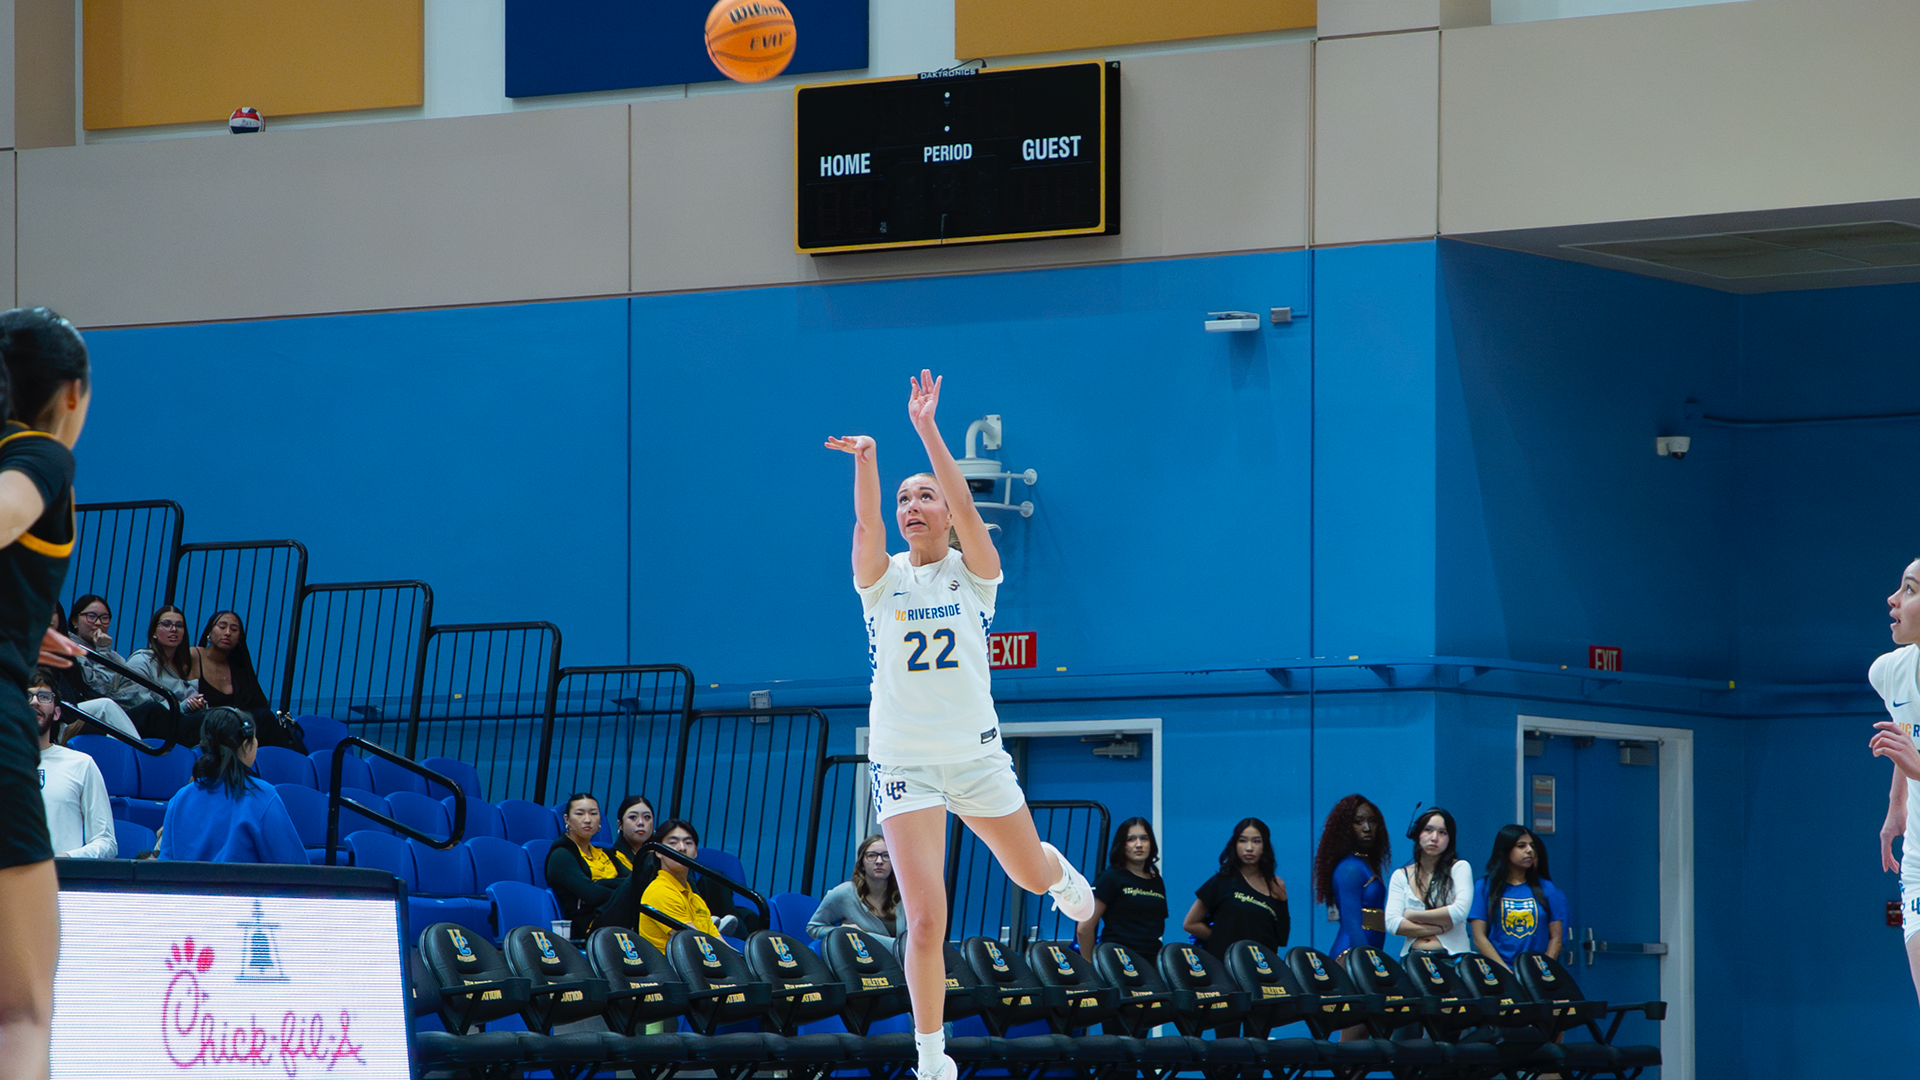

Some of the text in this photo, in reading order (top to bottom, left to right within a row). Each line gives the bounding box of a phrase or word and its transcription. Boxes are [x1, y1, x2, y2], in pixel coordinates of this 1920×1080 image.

[729, 2, 786, 24] Wilson
[920, 68, 976, 79] DAKTRONICS
[923, 143, 973, 162] PERIOD
[1022, 135, 1082, 161] GUEST
[820, 153, 871, 177] HOME
[903, 627, 959, 672] 22
[990, 635, 1029, 666] EXIT
[1595, 649, 1618, 671] EXIT
[162, 970, 366, 1077] Chick-fil-A
